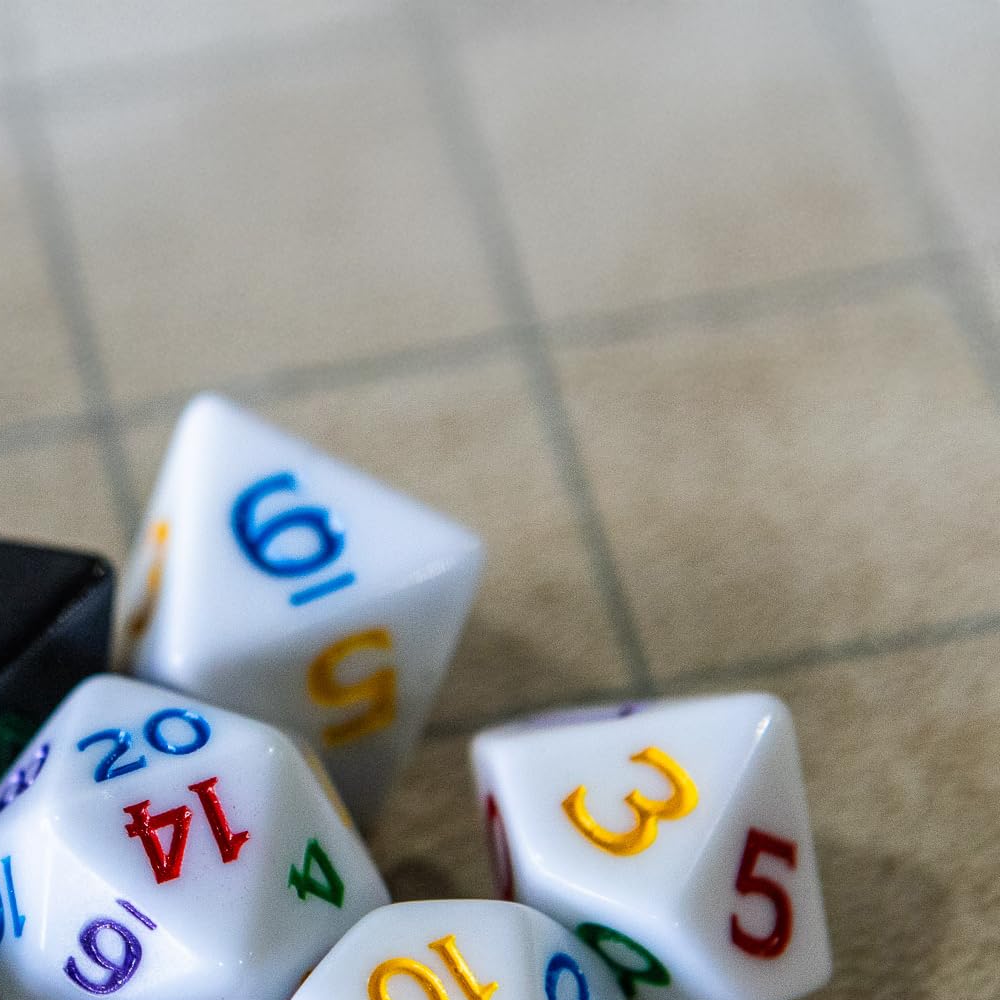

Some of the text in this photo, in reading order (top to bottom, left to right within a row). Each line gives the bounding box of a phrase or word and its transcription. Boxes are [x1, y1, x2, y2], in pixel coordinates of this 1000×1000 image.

[307, 625, 395, 747] 5
[77, 708, 210, 782] 20
[124, 776, 250, 884] 14
[561, 746, 698, 856] 3
[288, 837, 344, 908] 4
[730, 826, 797, 960] 5
